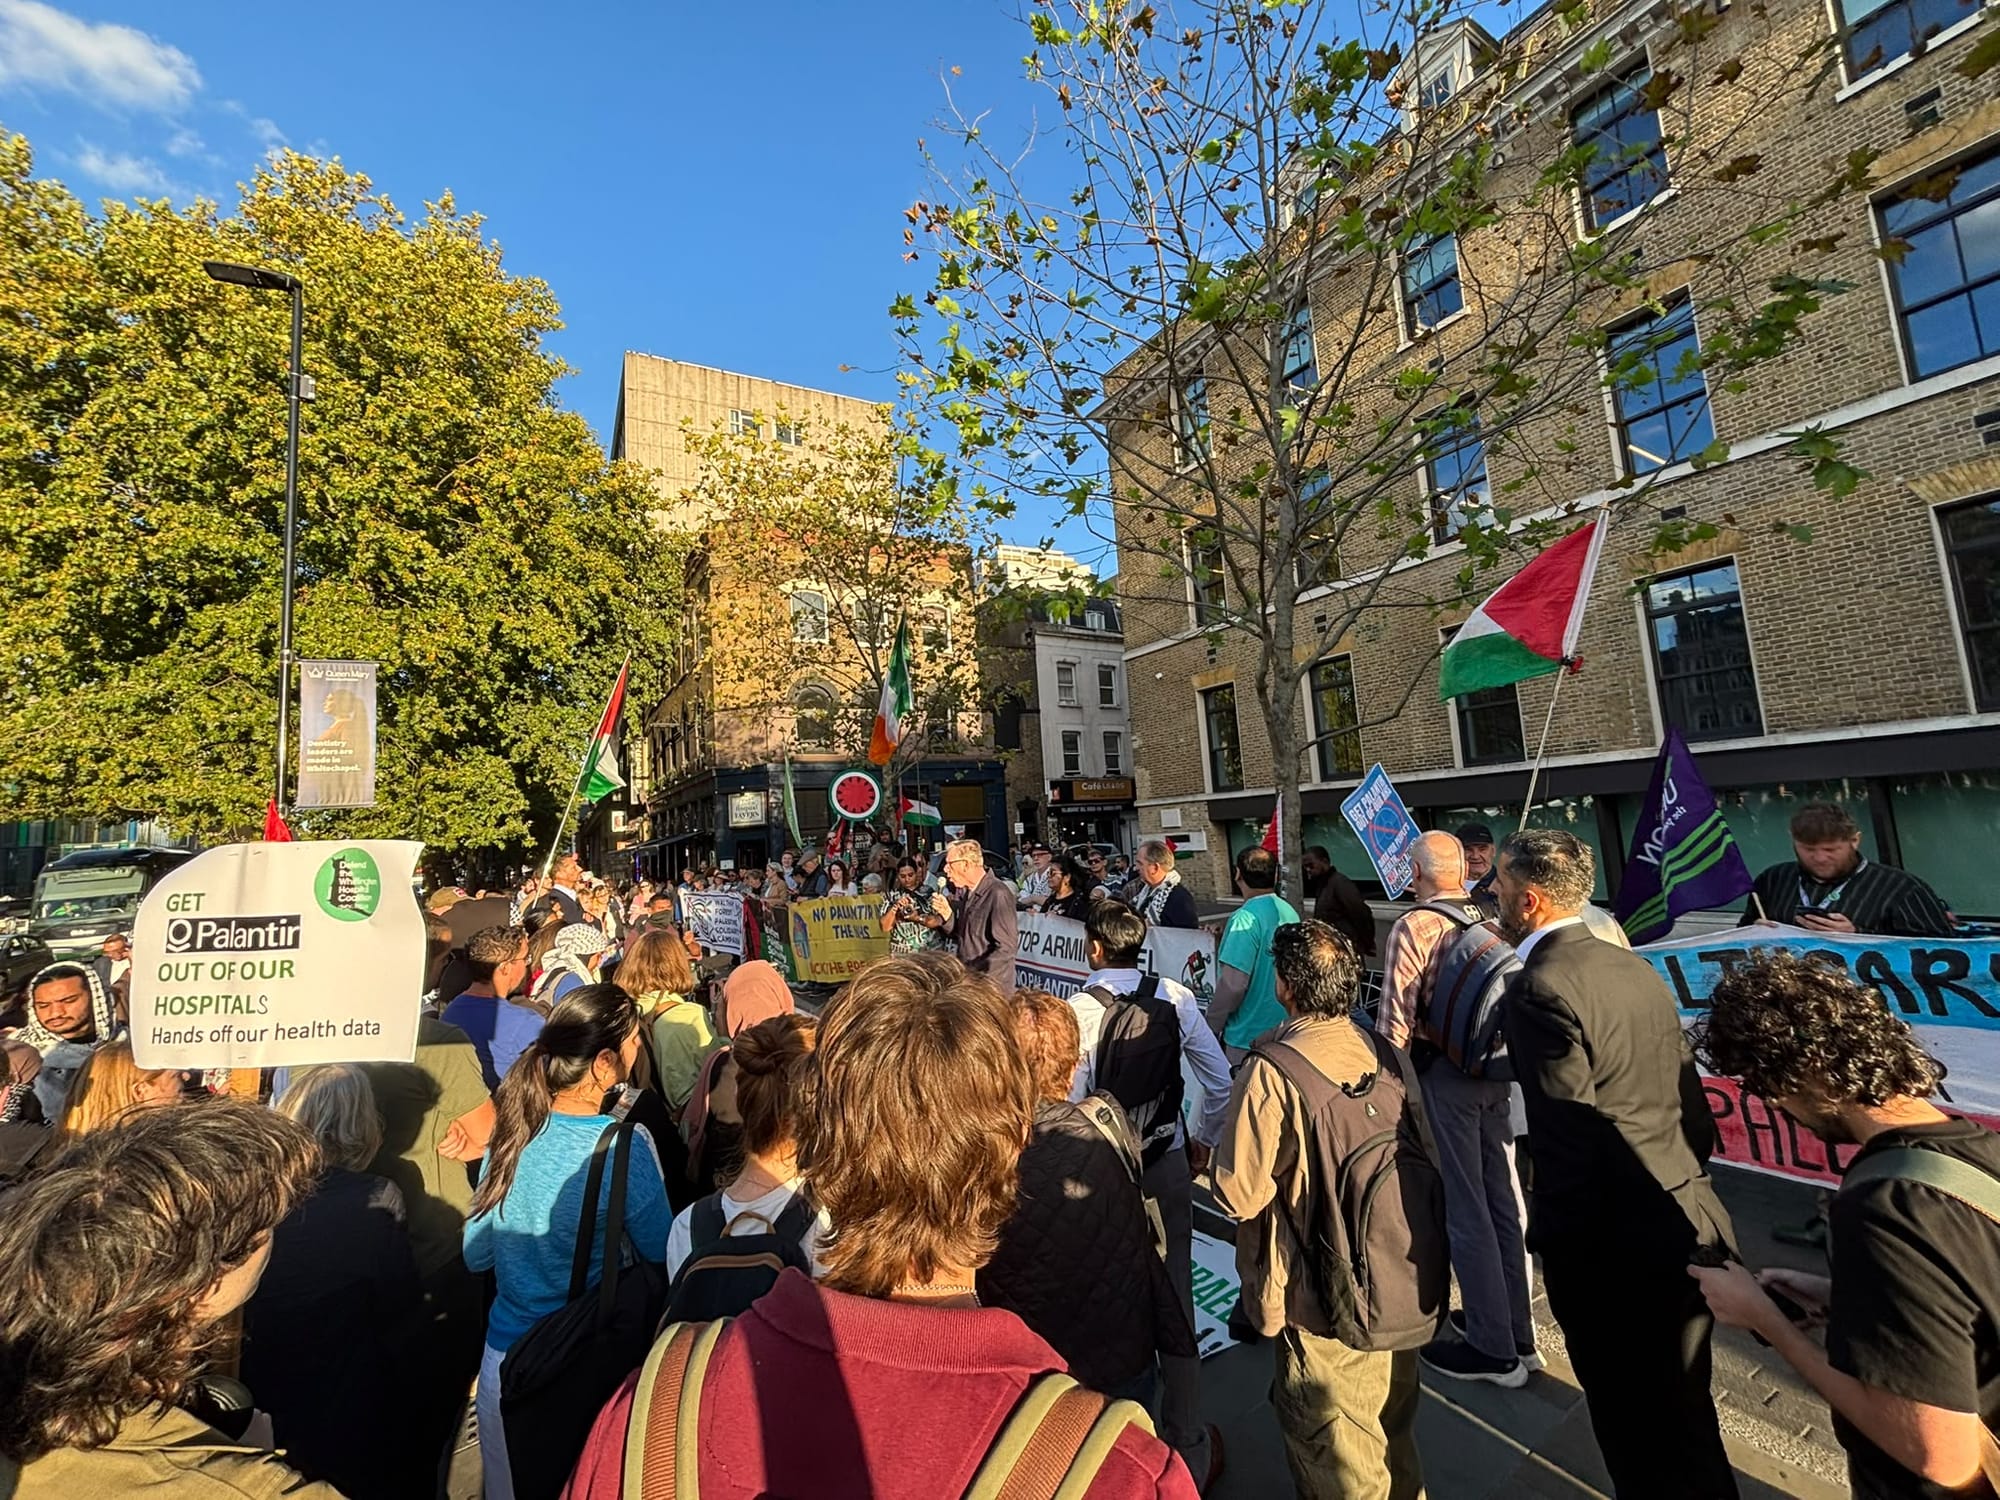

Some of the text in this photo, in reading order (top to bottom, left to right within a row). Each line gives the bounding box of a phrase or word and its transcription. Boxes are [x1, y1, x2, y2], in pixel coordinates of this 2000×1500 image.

[325, 670, 350, 678] Queen
[352, 670, 370, 680] Mary
[307, 740, 346, 748] Dentistry
[306, 764, 361, 773] Whitechapel.
[1348, 801, 1364, 822] GET
[1355, 814, 1369, 832] OUT
[166, 893, 205, 912] GET
[813, 907, 826, 922] NO
[196, 918, 300, 949] Palantir
[832, 925, 853, 939] THE
[1017, 930, 1086, 963] TOP ARMI
[158, 960, 295, 982] OUT OF OUR
[154, 994, 268, 1016] HOSPITALS
[151, 1018, 381, 1044] Hands off our health data
